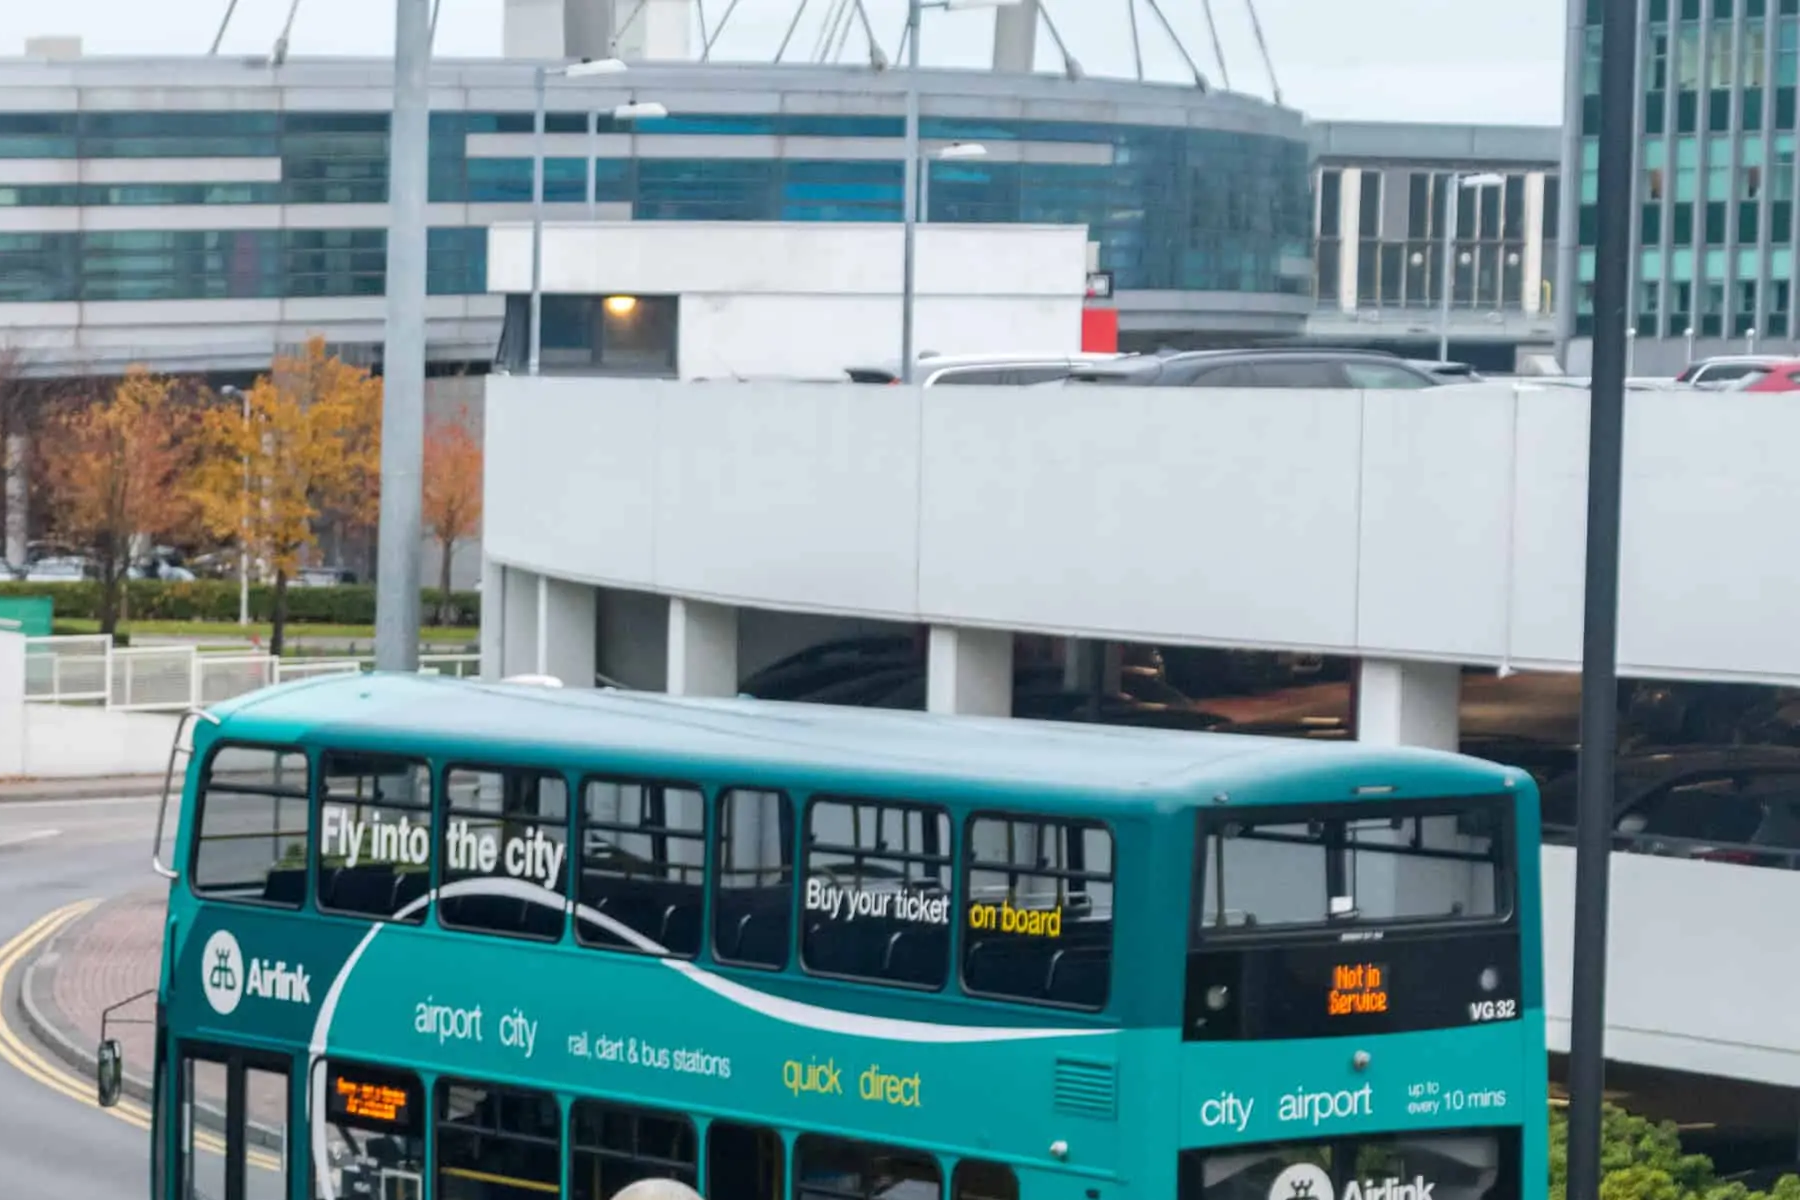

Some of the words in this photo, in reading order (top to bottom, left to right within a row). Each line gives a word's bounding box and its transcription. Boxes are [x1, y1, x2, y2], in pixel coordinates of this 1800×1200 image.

[322, 808, 364, 866] Fly
[371, 813, 430, 864] into
[446, 821, 499, 873] the
[504, 827, 566, 890] city
[806, 879, 843, 918] Buy
[846, 887, 891, 922] your
[894, 889, 950, 924] ticket
[968, 903, 997, 929] on
[1003, 901, 1061, 936] board
[246, 958, 311, 1004] Airlink
[1335, 964, 1363, 989] Not
[1366, 963, 1381, 987] in
[1328, 989, 1388, 1015] Service
[414, 997, 482, 1044] airport
[499, 1010, 538, 1057] city
[595, 1033, 625, 1062] dart
[628, 1037, 639, 1064] &
[641, 1039, 670, 1069] bus
[673, 1047, 732, 1079] stations
[783, 1054, 842, 1096] quick
[858, 1064, 922, 1107] direct
[1407, 1083, 1423, 1098] up
[1427, 1081, 1439, 1094] to
[1407, 1099, 1440, 1115] every
[1444, 1090, 1464, 1111] 10
[1468, 1088, 1506, 1109] mins
[1201, 1091, 1253, 1132] city
[1278, 1082, 1373, 1126] airport
